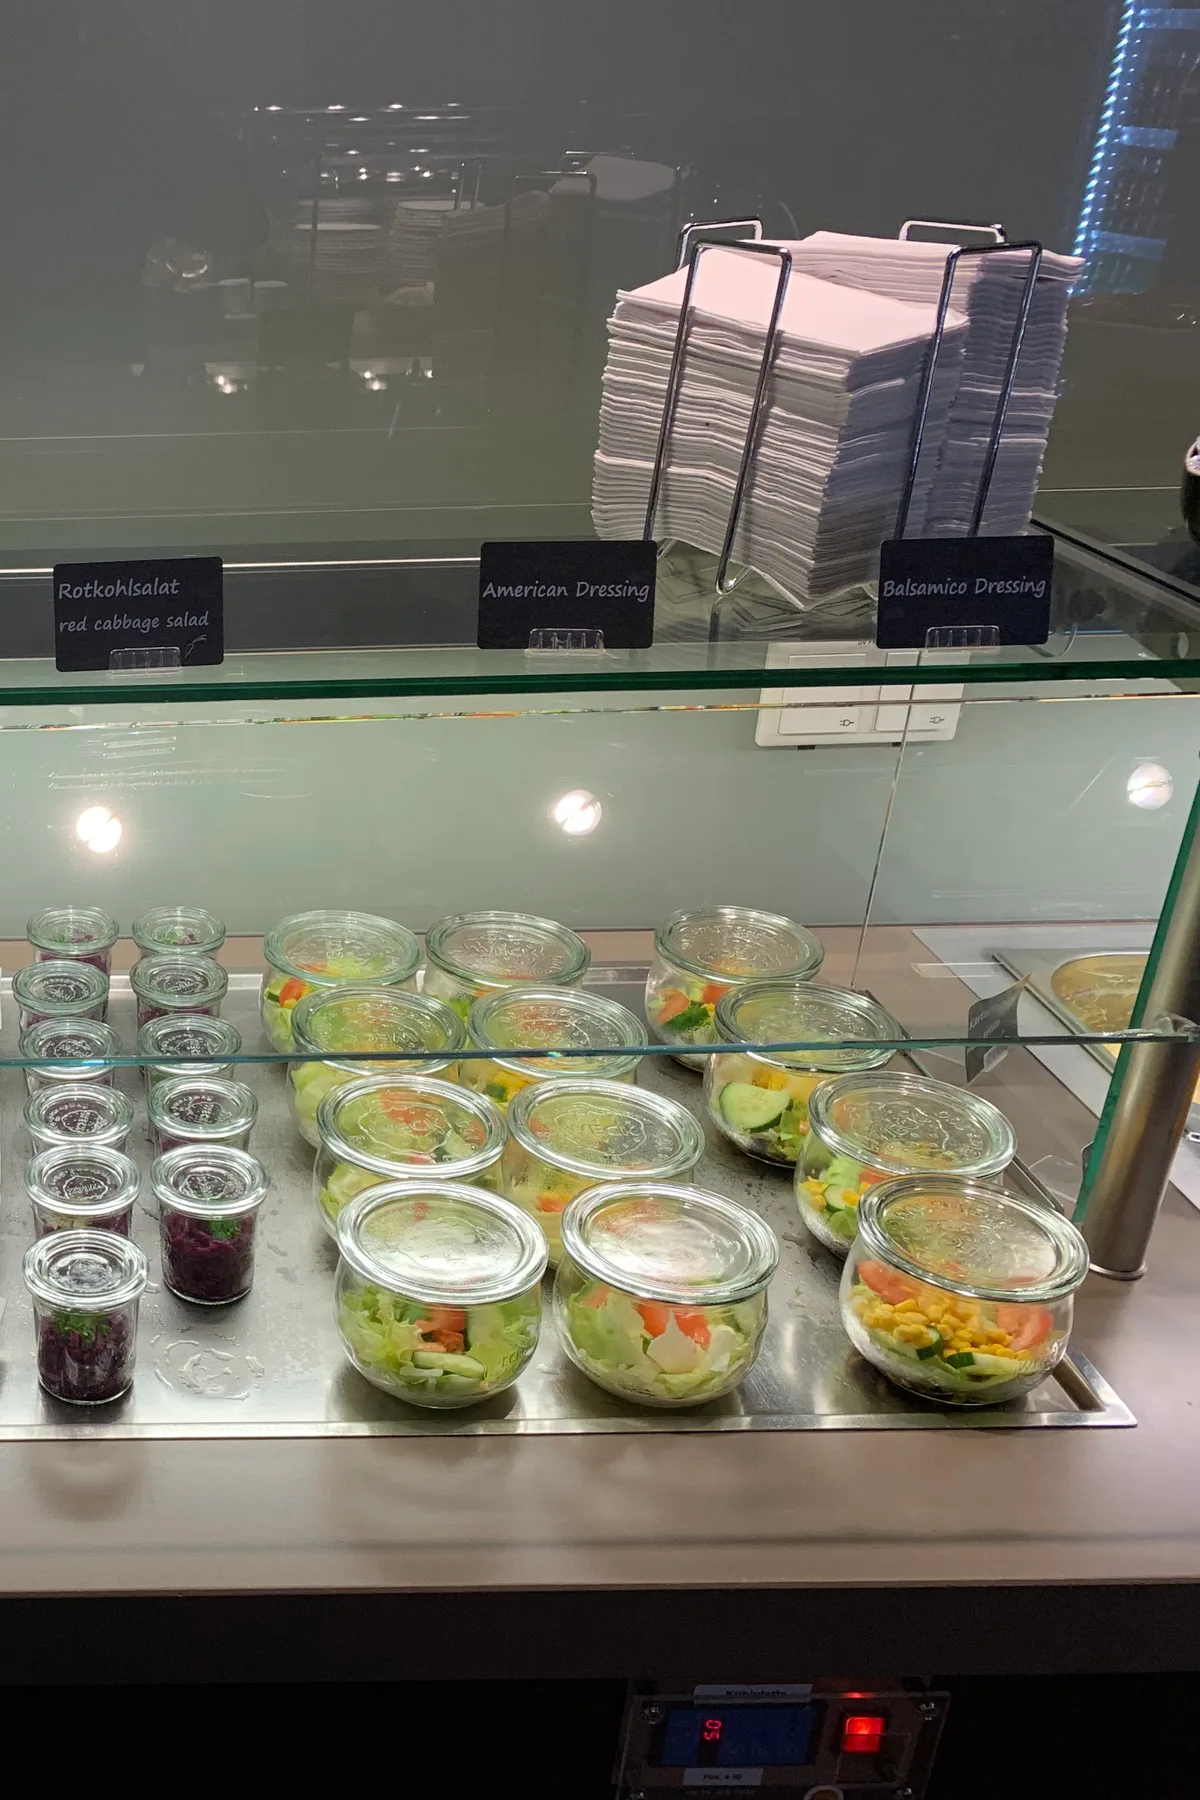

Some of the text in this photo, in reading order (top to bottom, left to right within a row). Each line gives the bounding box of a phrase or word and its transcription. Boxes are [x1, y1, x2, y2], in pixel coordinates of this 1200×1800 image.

[58, 577, 180, 599] Rotkohlsalat
[482, 580, 650, 602] American Dressing
[883, 575, 1046, 598] Balsamico Dressing
[59, 610, 210, 633] red cabbage salad
